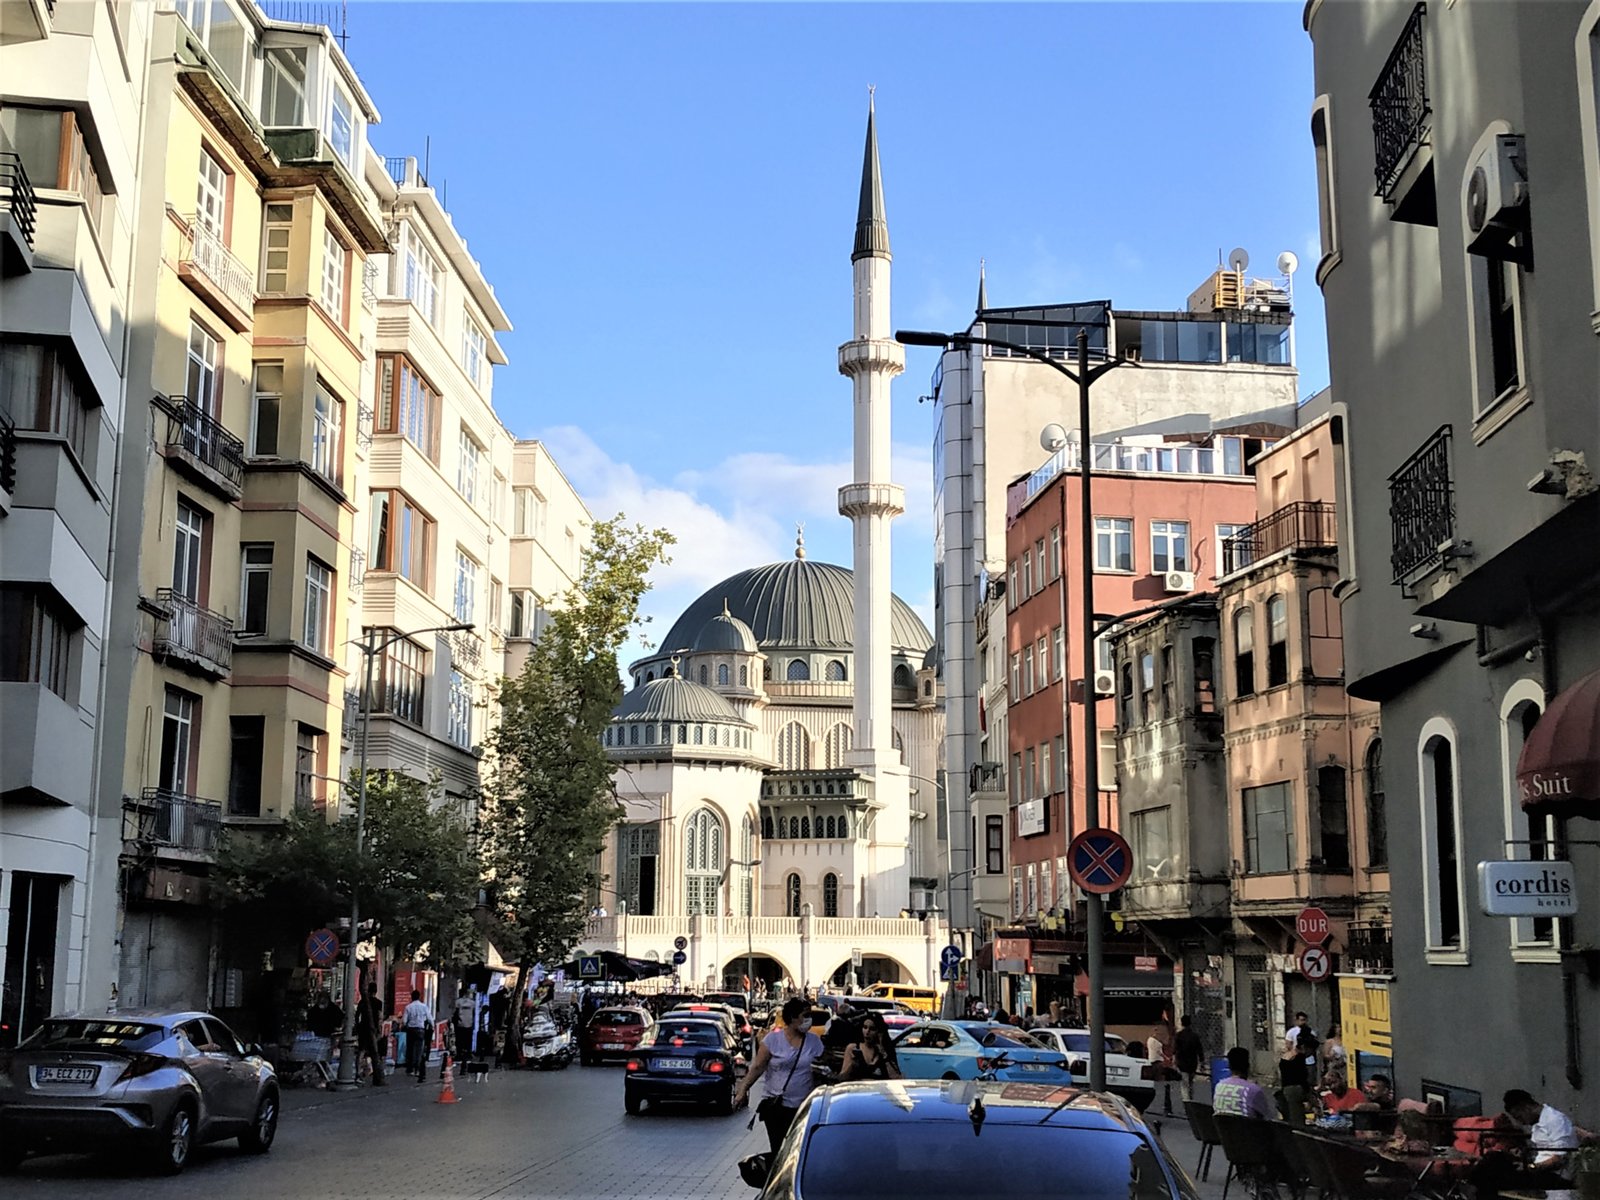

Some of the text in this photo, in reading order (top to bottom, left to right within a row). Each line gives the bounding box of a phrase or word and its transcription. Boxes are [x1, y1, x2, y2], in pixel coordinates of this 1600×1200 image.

[1533, 772, 1571, 797] Suit
[1496, 870, 1570, 894] cordis
[1537, 898, 1571, 907] hotel
[1300, 919, 1327, 932] DUR
[42, 1069, 92, 1079] 34 ECZ 217
